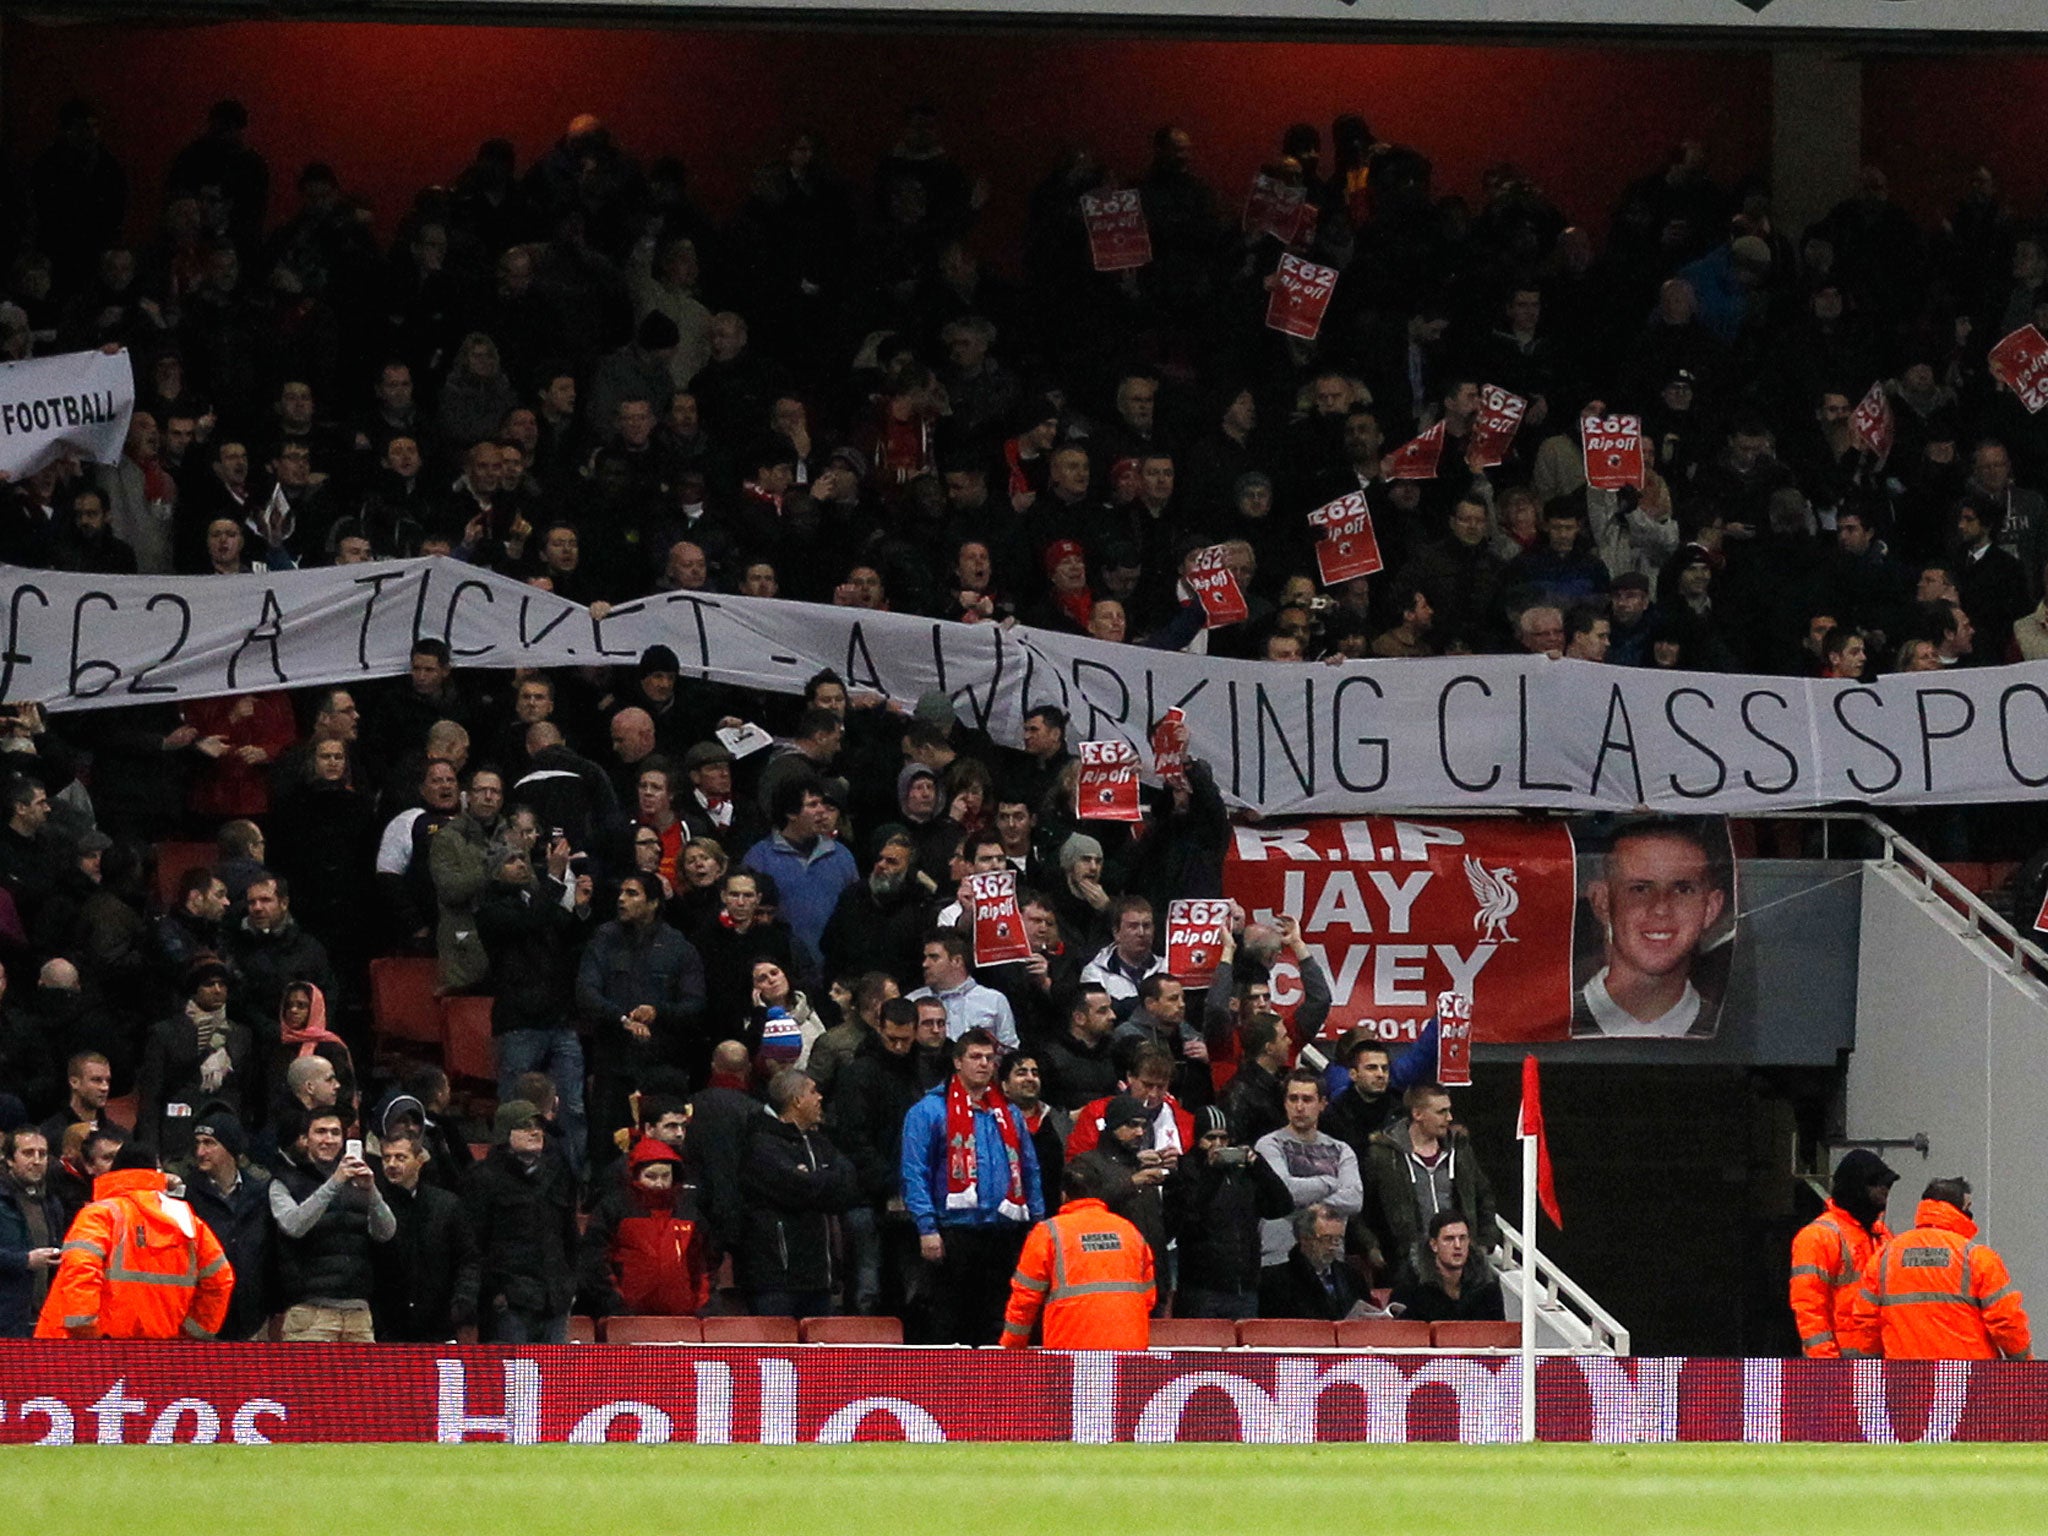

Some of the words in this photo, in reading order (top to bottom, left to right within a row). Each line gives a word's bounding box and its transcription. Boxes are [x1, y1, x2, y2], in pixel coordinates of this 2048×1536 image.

[1283, 255, 1335, 287] £62
[2, 390, 116, 434] FOOTBALL
[1585, 415, 1638, 435] £62
[1587, 436, 1614, 451] Rip
[1313, 495, 1366, 524] £62
[1328, 526, 1342, 542] ip
[227, 589, 289, 689] A
[847, 621, 891, 699] A
[1438, 674, 1798, 803] CLASS
[1084, 742, 1132, 765] £62
[1081, 768, 1108, 787] Rip
[1232, 820, 1465, 861] R.I.P
[972, 874, 1014, 900] £62
[978, 901, 998, 921] Rip
[1170, 900, 1230, 926] £62
[1252, 870, 1434, 933] JAY
[1169, 927, 1200, 947] Rip
